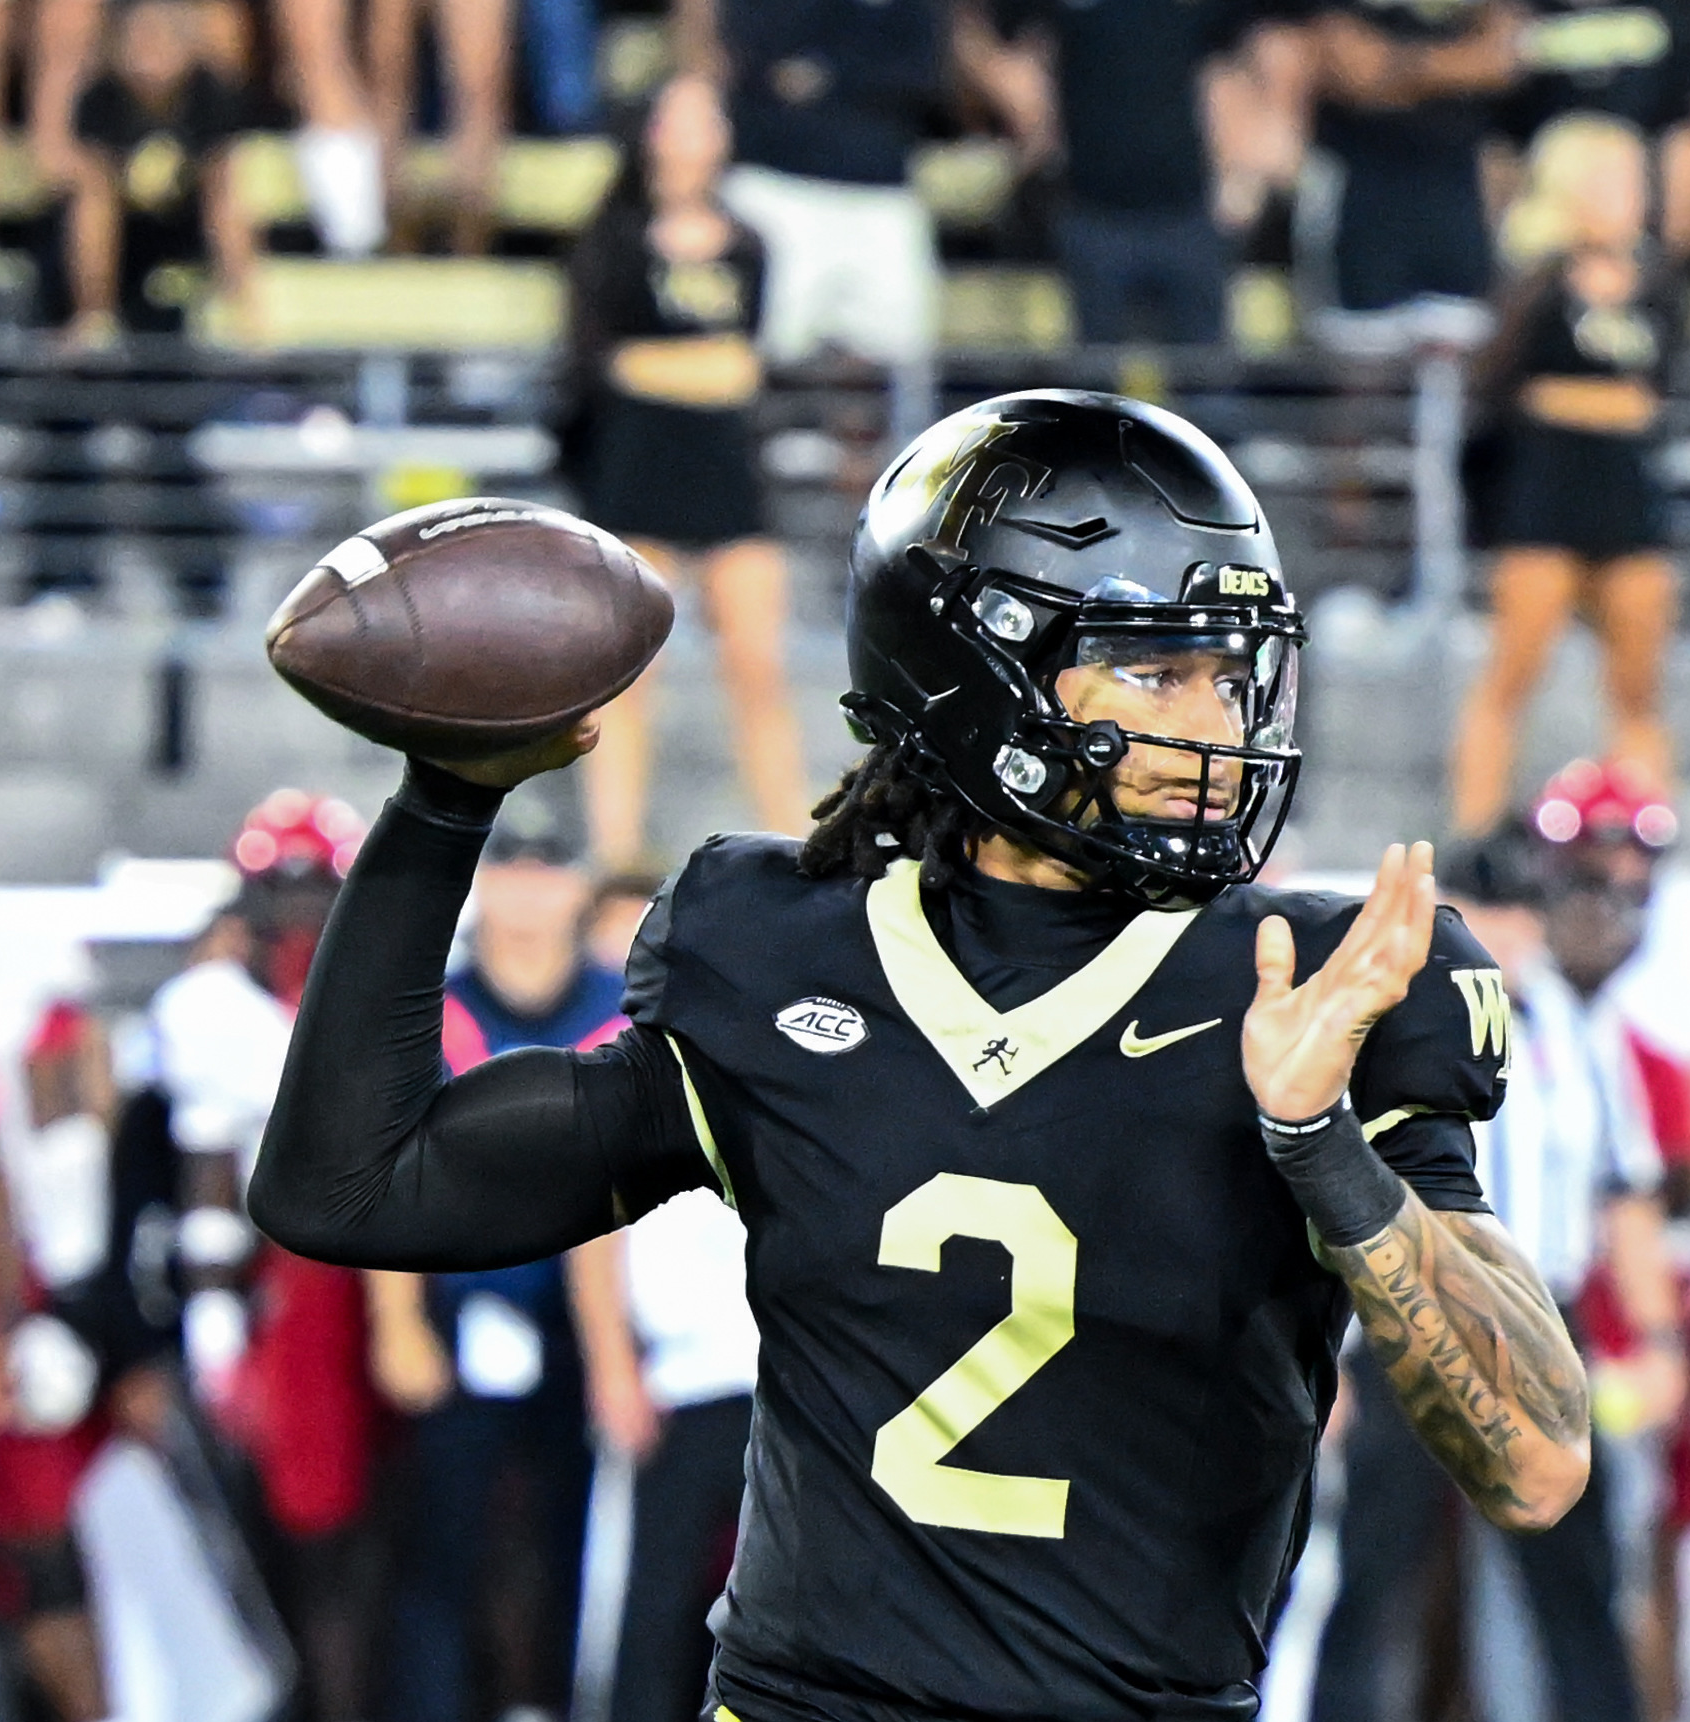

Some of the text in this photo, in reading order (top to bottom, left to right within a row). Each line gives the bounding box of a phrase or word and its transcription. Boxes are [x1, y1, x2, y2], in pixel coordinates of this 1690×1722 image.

[1219, 565, 1270, 596] DEACS
[789, 1011, 858, 1037] ACC
[871, 1171, 1079, 1539] 2
